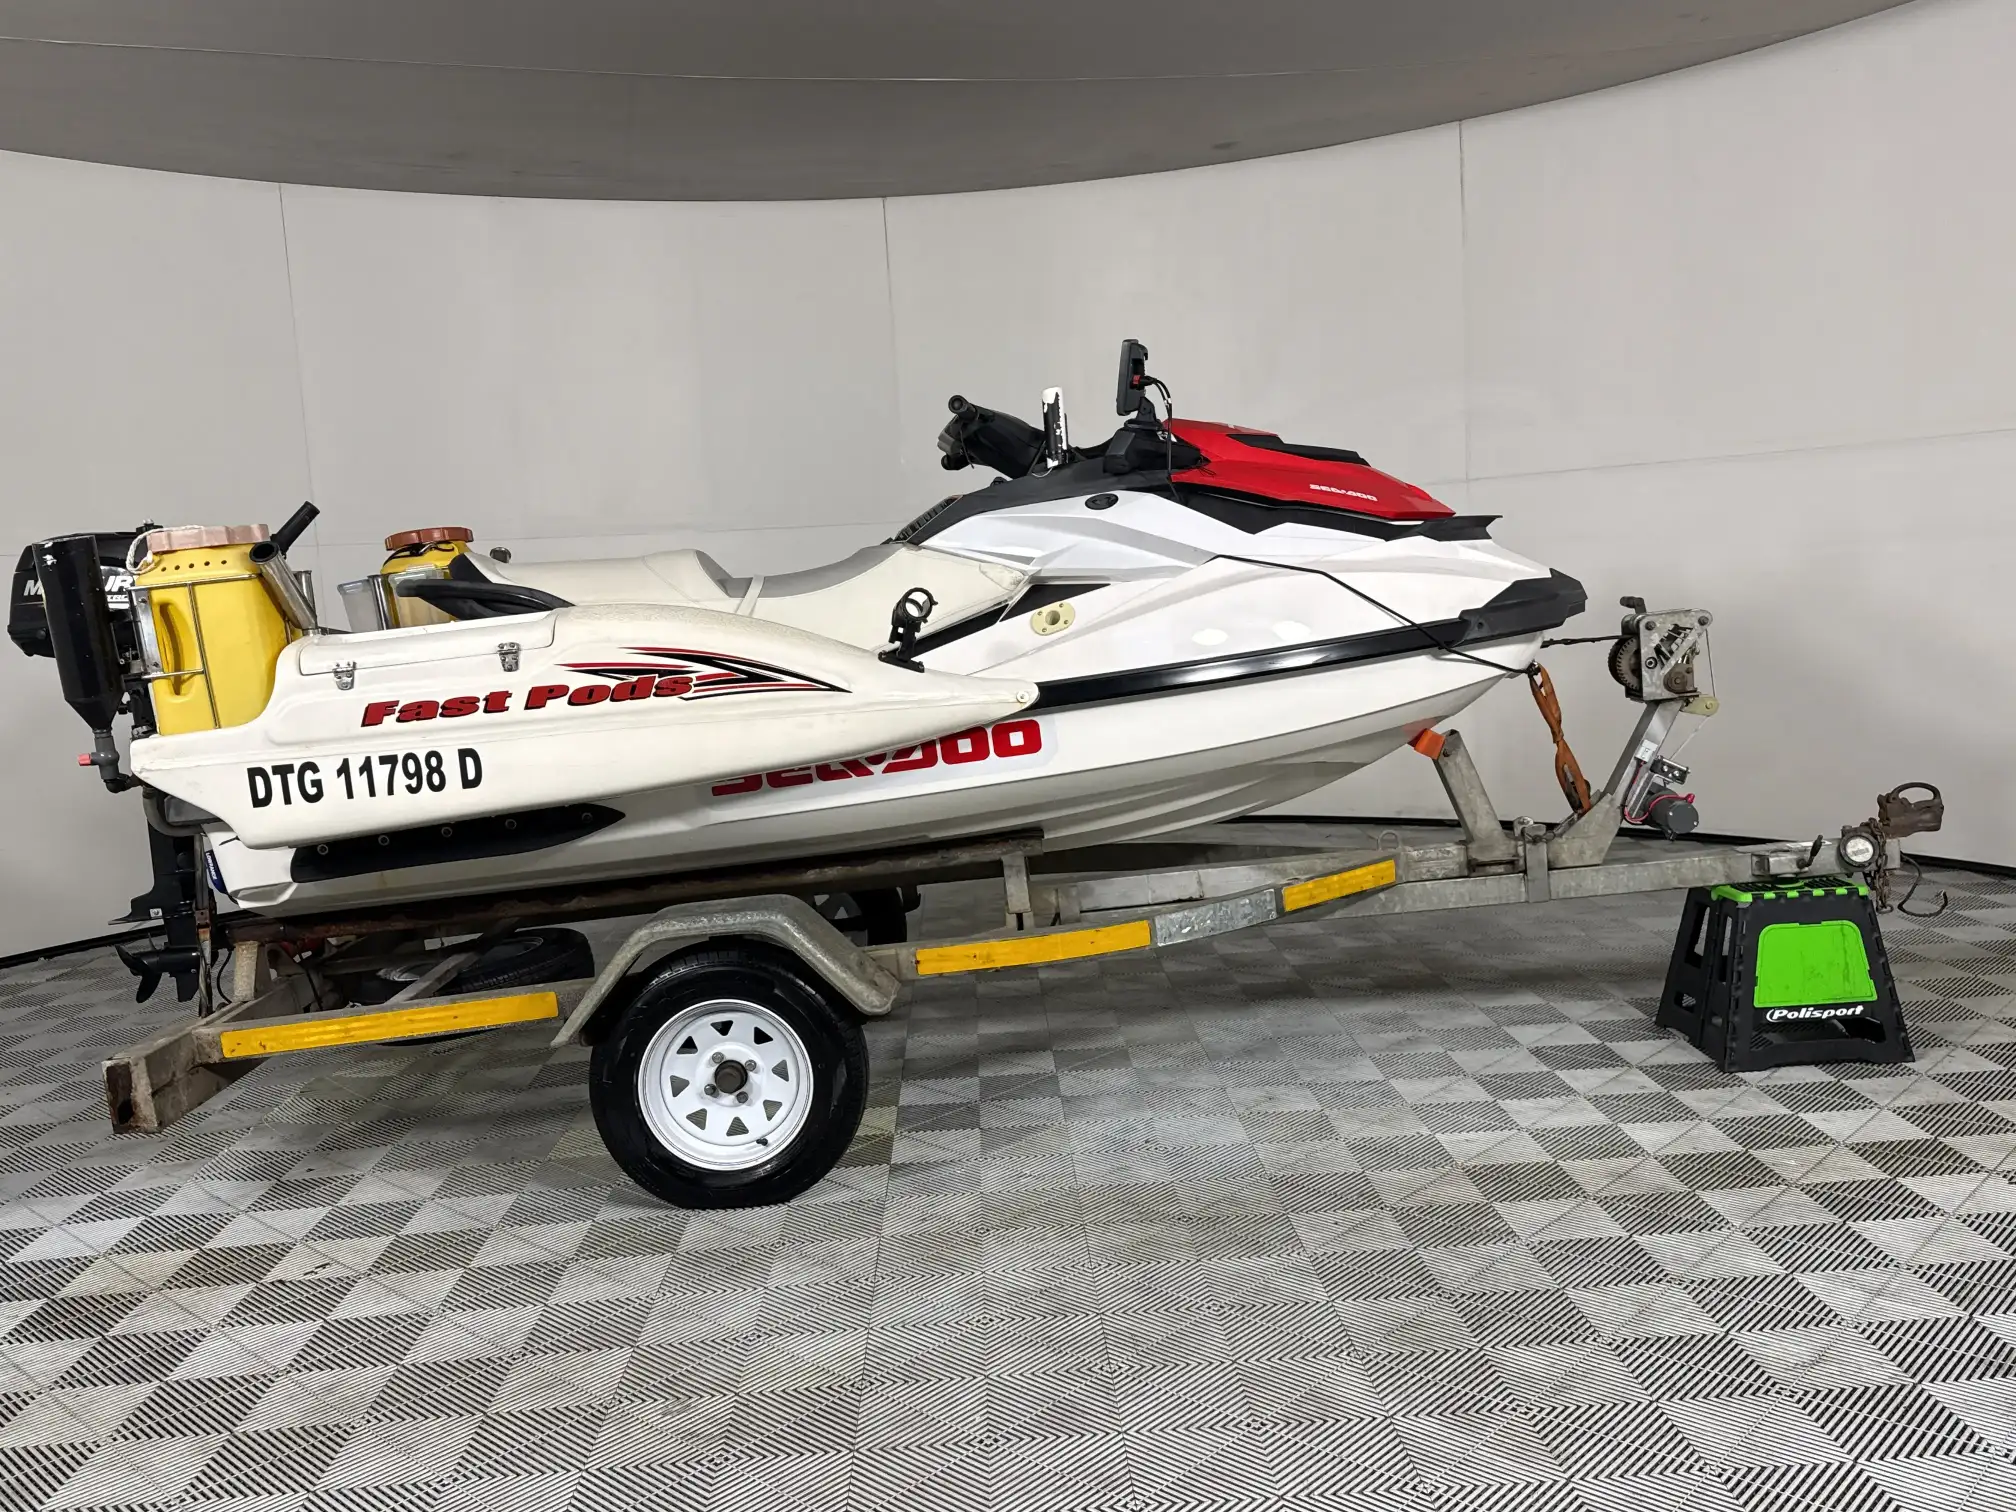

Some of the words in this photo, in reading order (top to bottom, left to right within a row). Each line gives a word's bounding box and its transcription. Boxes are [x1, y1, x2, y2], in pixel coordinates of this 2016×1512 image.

[361, 690, 513, 727] Fast
[524, 675, 695, 711] Pods
[246, 761, 324, 808] DTG
[336, 750, 447, 800] 11798
[457, 747, 483, 790] D
[1770, 1005, 1864, 1020] Polisport
